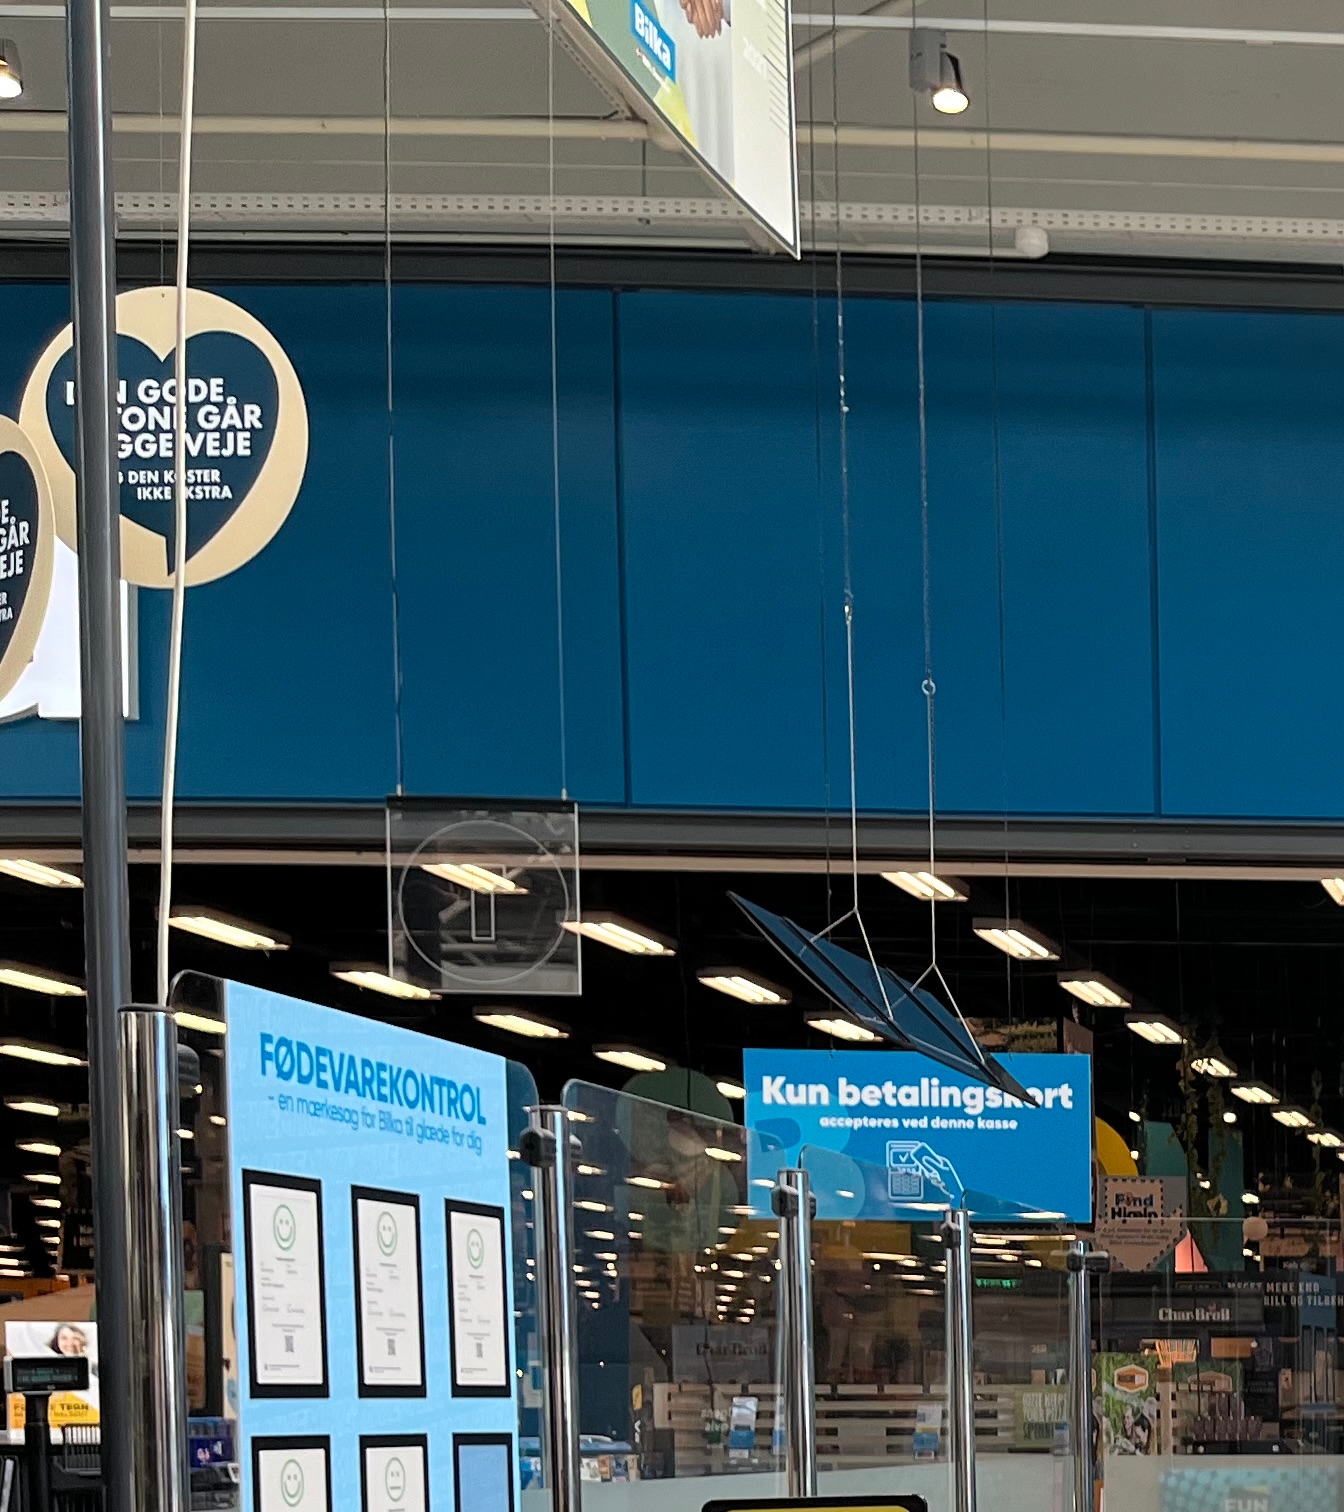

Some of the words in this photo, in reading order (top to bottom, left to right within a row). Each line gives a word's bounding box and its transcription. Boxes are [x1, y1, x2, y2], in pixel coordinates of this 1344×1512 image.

[634, 2, 671, 72] Bilka
[197, 396, 262, 430] GÅR
[185, 431, 251, 457] VEJE
[129, 470, 158, 484] DEN
[137, 486, 172, 500] IKKE
[260, 1032, 486, 1125] FØDEVAREKONTROL
[762, 1075, 830, 1106] Kun
[300, 1097, 359, 1130] mærkesag
[379, 1110, 402, 1132] Bilka
[819, 1116, 899, 1130] accepteres
[902, 1116, 928, 1129] ved
[931, 1117, 974, 1129] denne
[978, 1117, 1018, 1130] kasse
